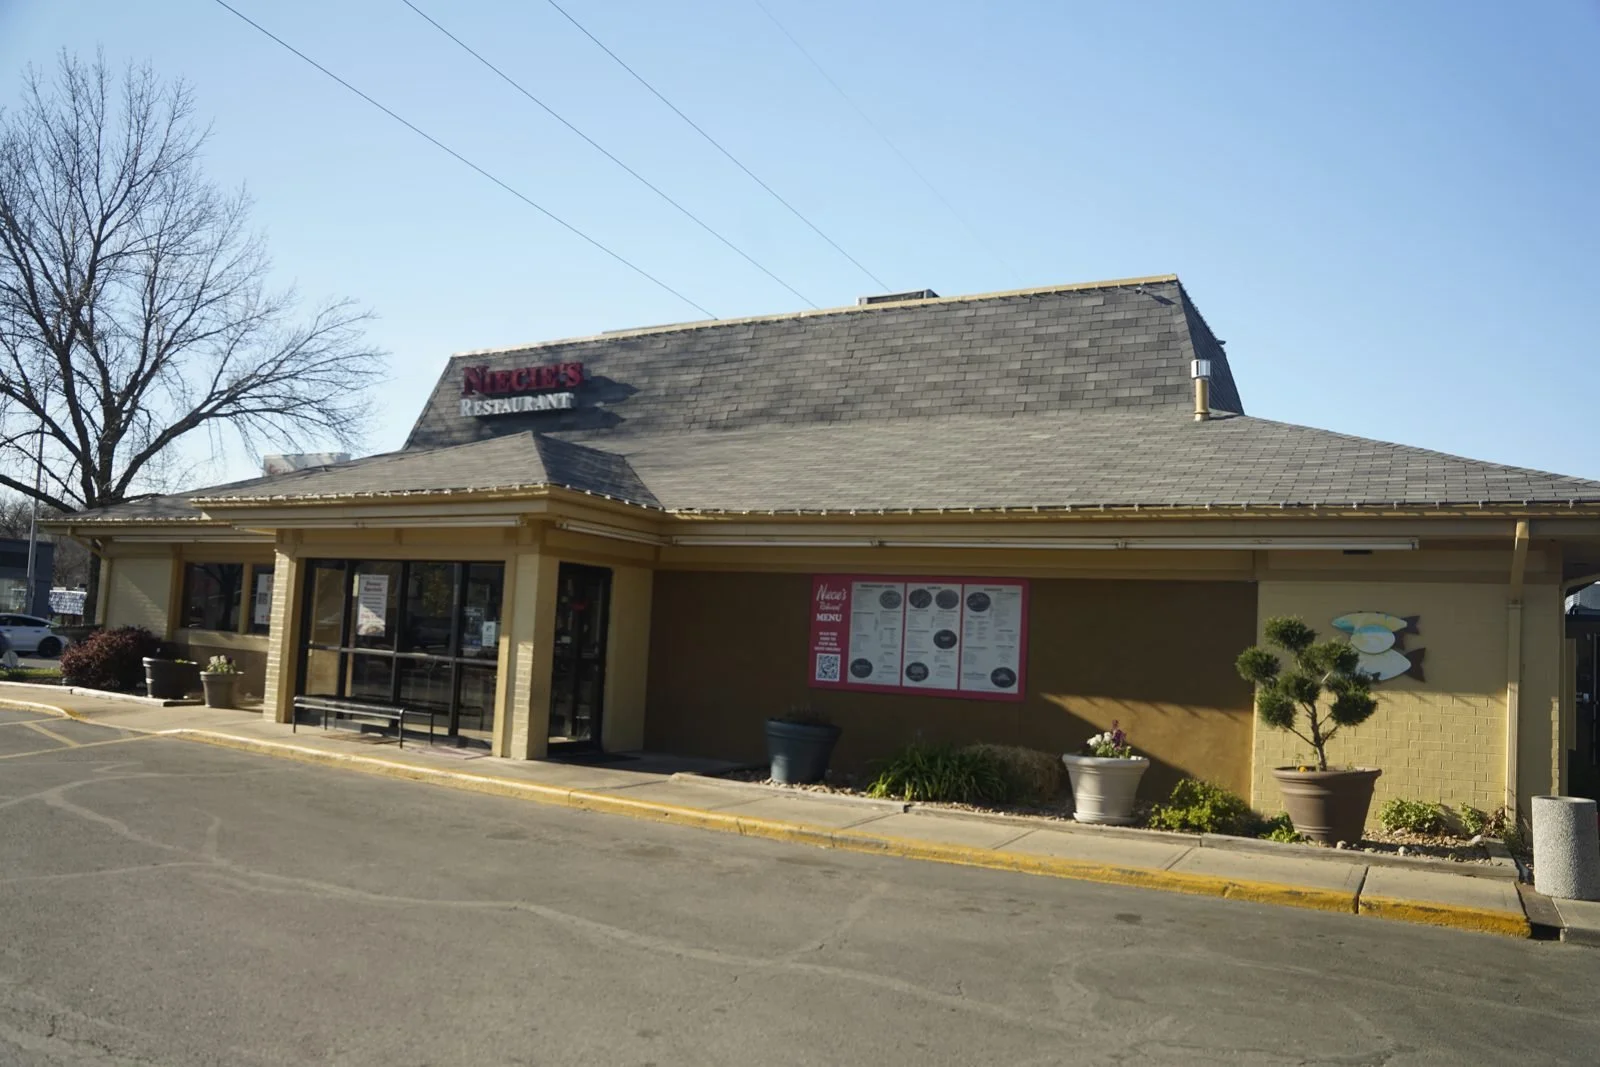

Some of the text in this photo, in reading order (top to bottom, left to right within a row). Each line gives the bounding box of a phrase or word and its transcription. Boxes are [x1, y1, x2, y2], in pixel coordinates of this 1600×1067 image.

[461, 362, 584, 395] NIECIE'S
[460, 392, 574, 417] RESTAURANT
[816, 613, 842, 622] MENU
